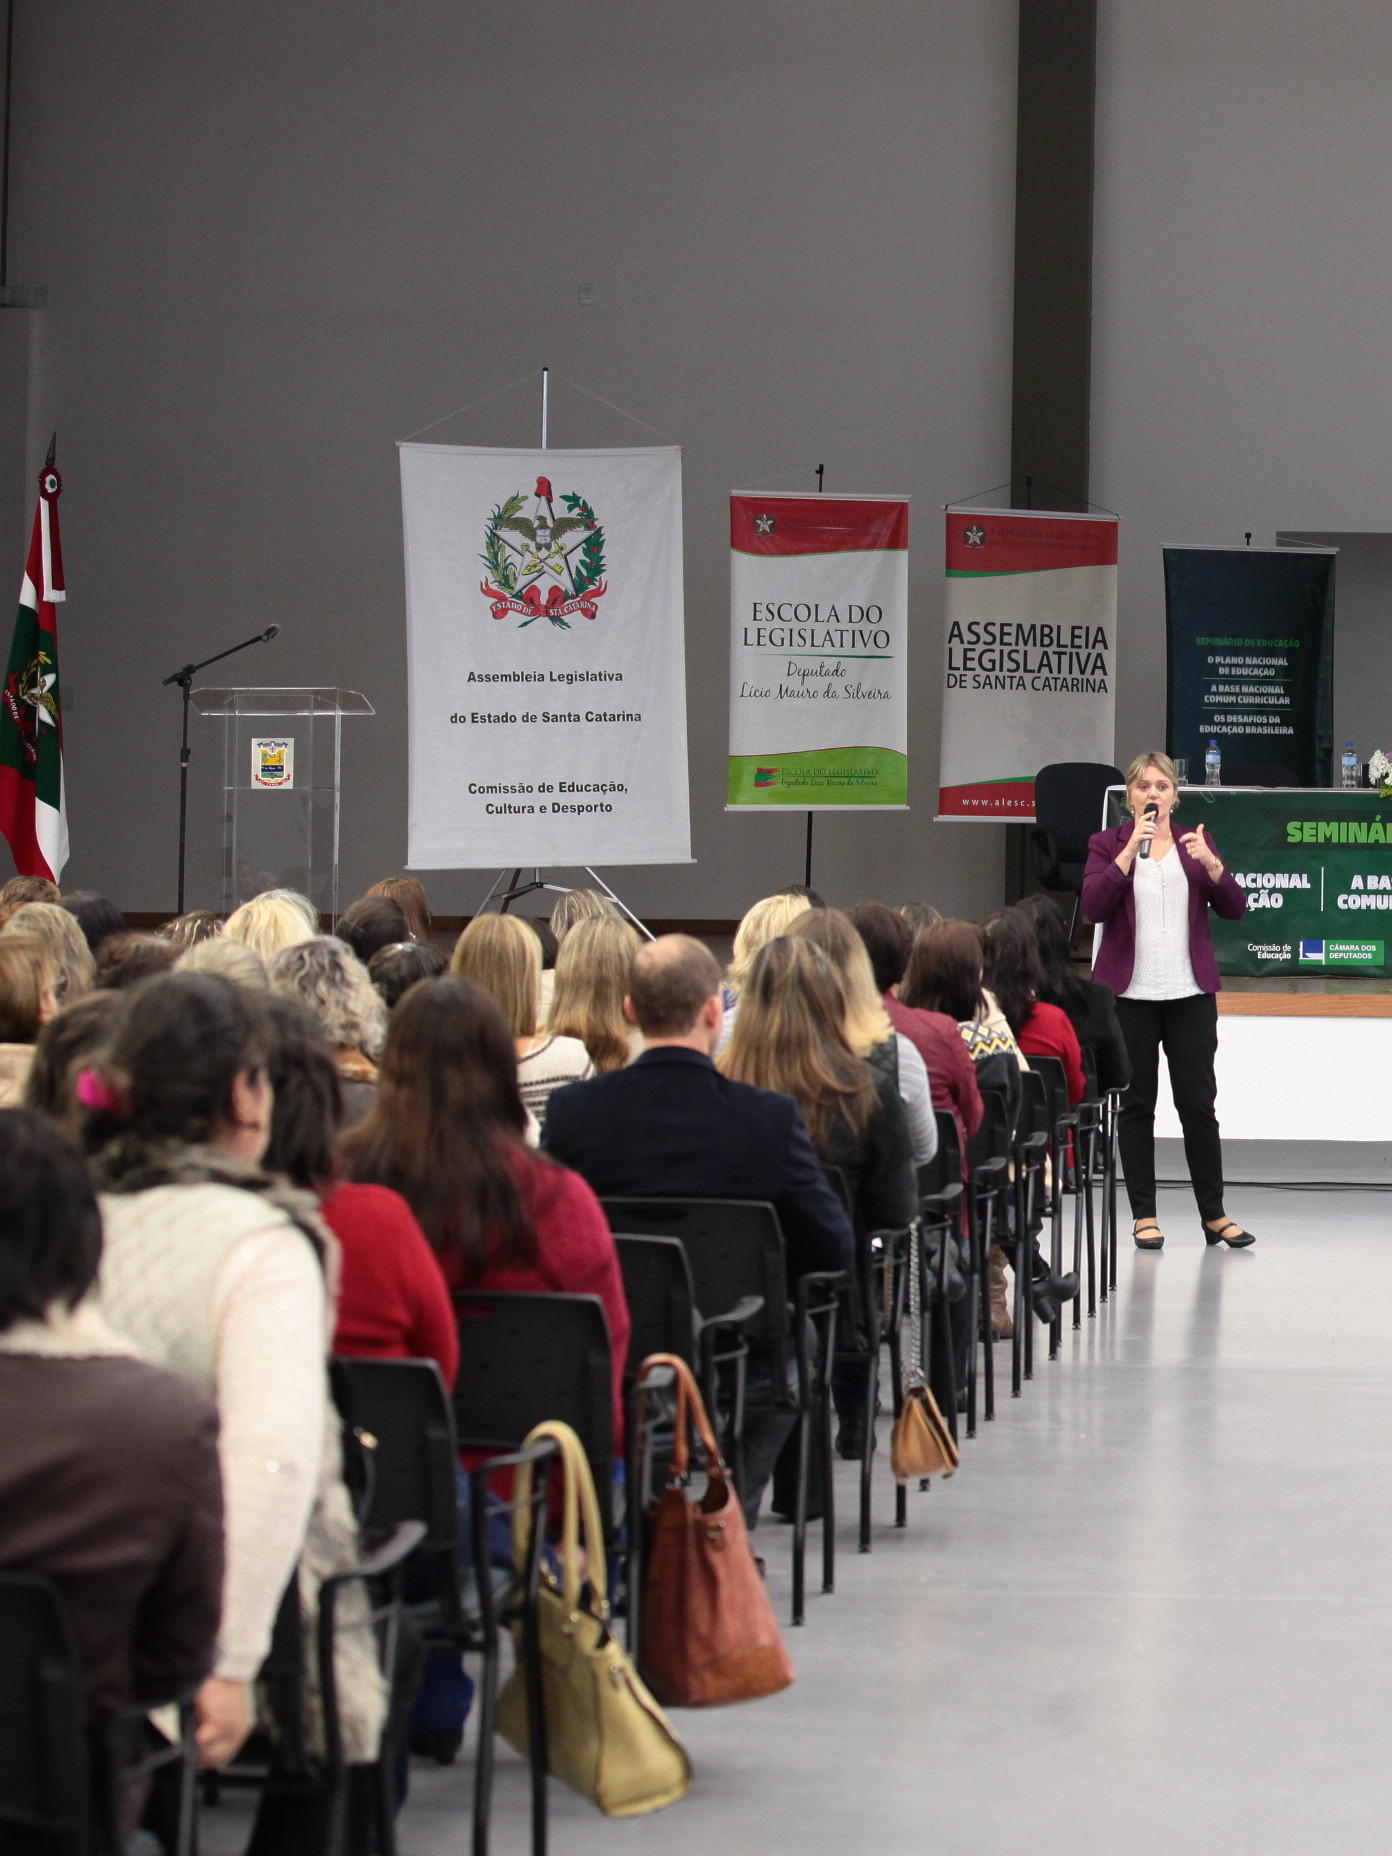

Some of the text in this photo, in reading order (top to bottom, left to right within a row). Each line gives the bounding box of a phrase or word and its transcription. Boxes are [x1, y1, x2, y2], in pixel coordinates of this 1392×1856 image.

[752, 602, 883, 624] ESCOLA DO
[743, 628, 890, 649] LEGISLATIVO
[948, 621, 1109, 650] ASSEMBLEIA
[1244, 638, 1255, 646] DE
[948, 647, 1108, 676] LEGISLATIVA
[1215, 656, 1244, 664] PLANO
[1245, 657, 1288, 665] NACIONAL
[787, 660, 846, 686] Deputado
[1219, 667, 1230, 675] DE
[467, 671, 622, 685] Assembleia Legislativa
[947, 674, 1108, 693] DE SANTA CATARINA
[740, 682, 891, 699] Lício Mauro da Silveira
[1211, 684, 1285, 693] A BASE NACIONAL
[1204, 695, 1290, 704] COMUM CURRICULAR
[450, 711, 641, 723] do Estado de Santa Catarina
[1227, 715, 1268, 723] DESAFIOS
[1245, 726, 1294, 735] BRASILEIRA
[468, 782, 627, 794] Comissão de Educação,
[486, 802, 612, 815] Cultura e Desporto
[1231, 873, 1311, 889] ACIONAL
[1350, 875, 1364, 890] A
[1247, 944, 1291, 952] Comissão de
[1329, 943, 1360, 951] CÂMARA
[1258, 951, 1291, 961] Educação
[1329, 952, 1372, 960] DEPUTADOS
